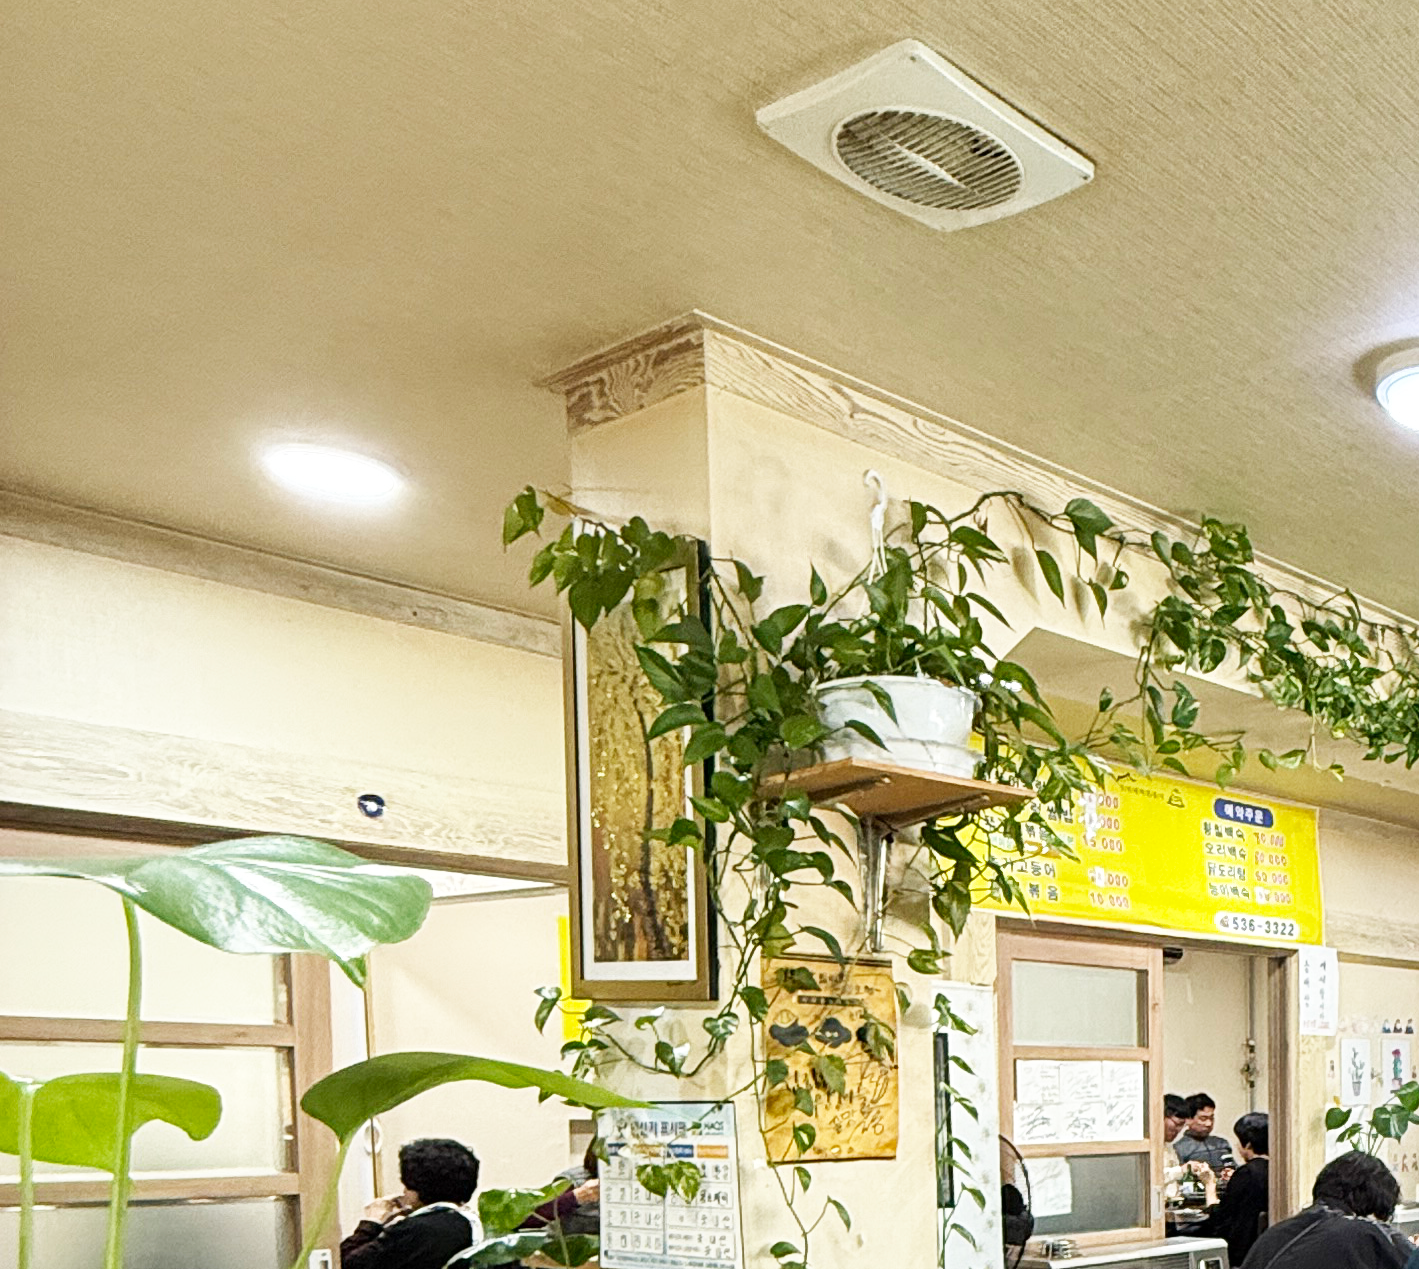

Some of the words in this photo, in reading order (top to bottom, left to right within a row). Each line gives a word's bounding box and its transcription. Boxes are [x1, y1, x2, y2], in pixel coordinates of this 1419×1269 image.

[1224, 803, 1264, 825] 예약주문
[1205, 842, 1246, 860] 오리백숙
[1232, 916, 1295, 937] 536-3322
